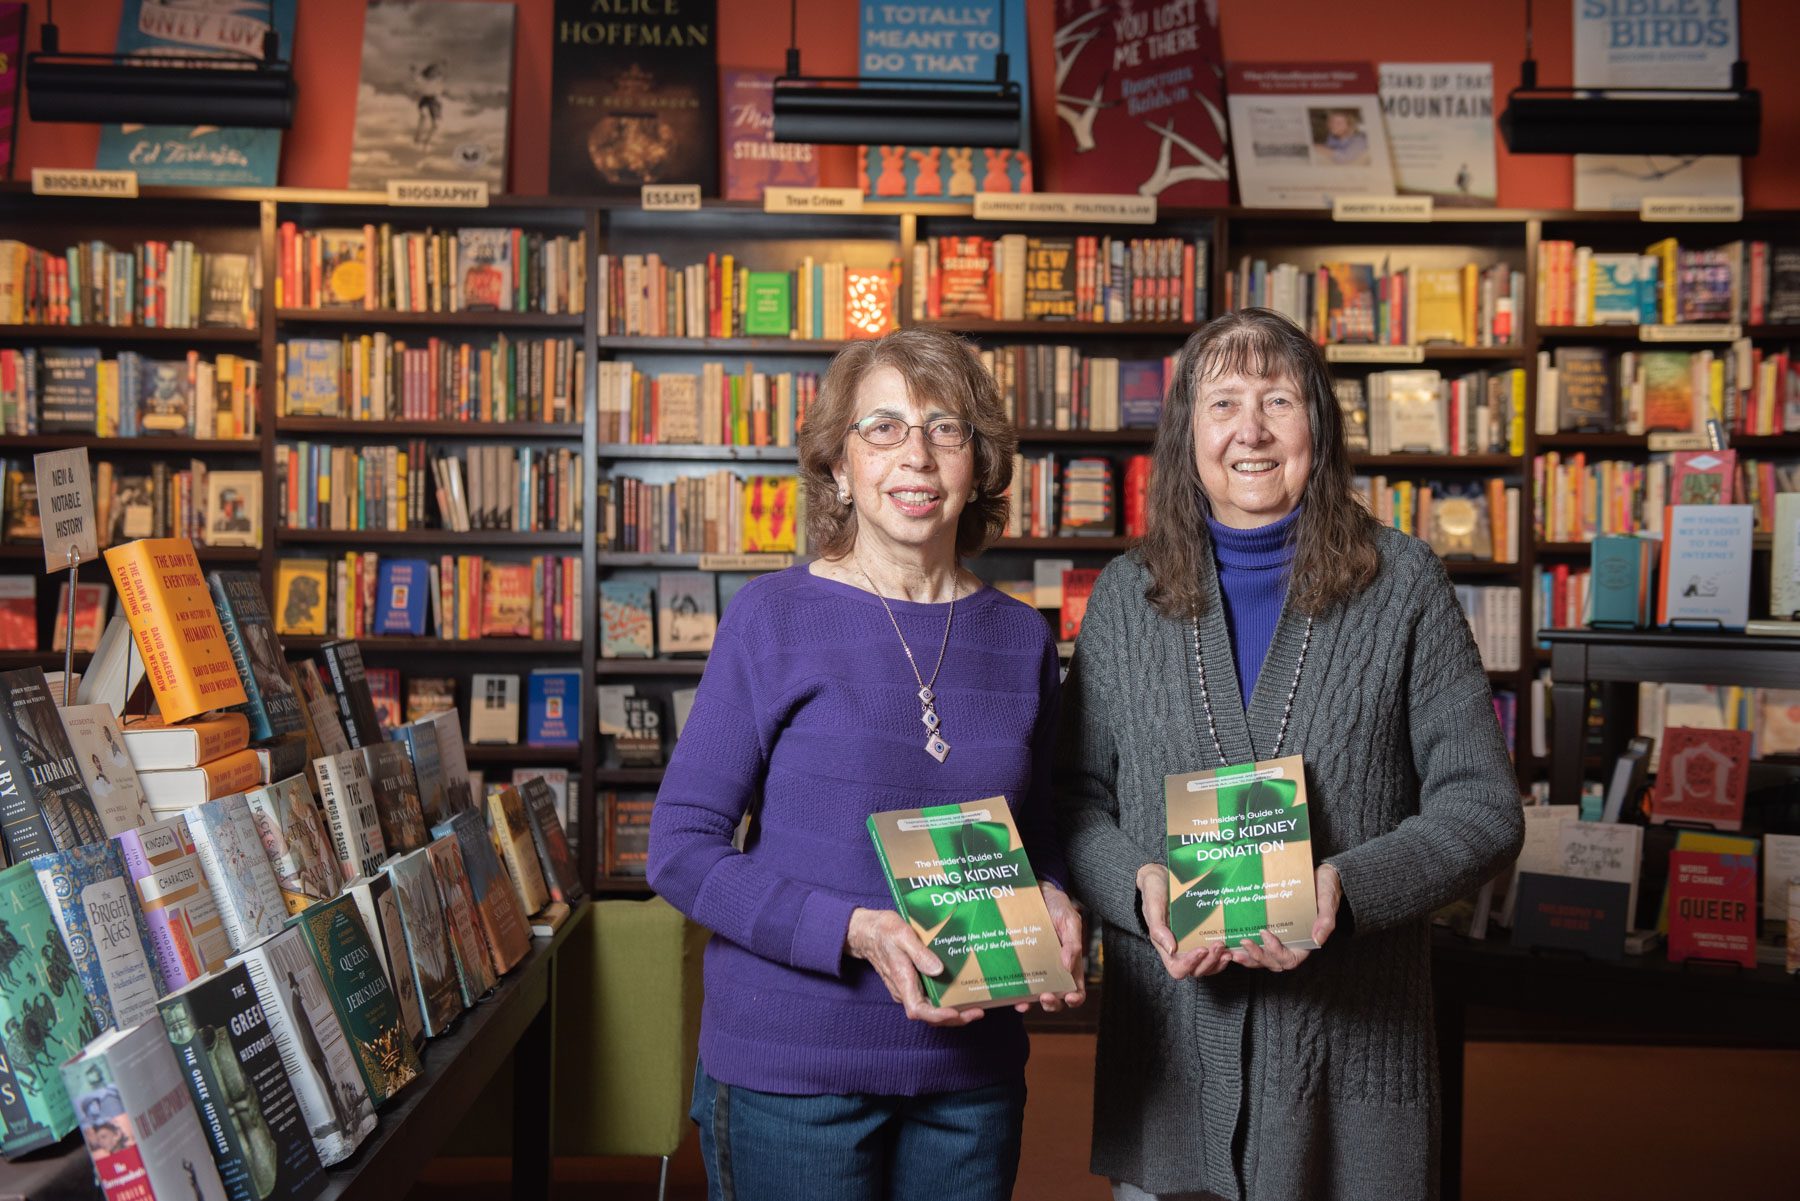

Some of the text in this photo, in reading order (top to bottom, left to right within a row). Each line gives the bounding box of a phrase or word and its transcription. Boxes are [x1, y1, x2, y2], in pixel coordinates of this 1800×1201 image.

[866, 6, 993, 25] I TOTALLY
[560, 21, 708, 46] HOFFMAN
[866, 30, 999, 50] MEANT TO
[1610, 18, 1729, 48] BIRDS
[865, 53, 979, 73] DO THAT
[1431, 74, 1452, 89] UP
[1456, 75, 1493, 89] THAT
[1382, 97, 1494, 119] MOUNTAIN
[42, 175, 128, 191] BIOGRAPHY
[397, 186, 480, 202] BIOGRAPHY
[646, 191, 697, 205] ESSAYS
[786, 195, 845, 207] True Crime
[52, 467, 74, 487] NEW &
[51, 491, 82, 513] NOTABLE
[55, 516, 83, 538] HISTORY
[154, 553, 195, 569] THE DAWN OF
[117, 566, 141, 616] EVERYTHING
[128, 560, 152, 614] THE DAWN OF
[163, 574, 200, 589] EVERYTHING
[180, 611, 190, 620] NEW
[182, 625, 218, 643] HUMANITY
[140, 630, 167, 692] DAVID WENGROW
[150, 627, 177, 684] DAVID GRAEBER
[193, 664, 210, 677] DAVID
[200, 681, 216, 694] DAVID
[30, 757, 78, 785] LIBRARY
[346, 782, 362, 806] THE
[252, 797, 271, 838] TRACE
[266, 838, 275, 848] &
[318, 764, 350, 861] HOW THE WORD IS PASSED
[1192, 818, 1209, 826] The
[1210, 813, 1246, 824] Insider's
[1247, 810, 1274, 819] Guide
[1181, 818, 1298, 845] LIVING KIDNEY
[144, 834, 174, 851] KINGDOM
[360, 832, 370, 855] IS
[1196, 839, 1285, 862] DONATION
[131, 848, 142, 866] JING
[914, 852, 1003, 869] The Insider's Guide to
[159, 867, 195, 890] CHARACTERS
[909, 863, 1020, 889] LIVING KIDNEY
[1679, 864, 1708, 874] WORDS
[1185, 888, 1220, 899] Everything
[1220, 887, 1234, 896] You
[1235, 884, 1253, 893] Need
[1261, 881, 1279, 890] Know
[1679, 874, 1724, 886] OF CHANGE
[930, 884, 1016, 907] DONATION
[1196, 899, 1211, 908] Give
[1223, 896, 1240, 906] Get)
[1251, 892, 1279, 902] Greatest
[1279, 889, 1294, 899] Gift
[89, 894, 130, 925] BRIGHT
[1680, 898, 1747, 921] QUEER
[102, 919, 131, 950] AGES
[934, 933, 967, 946] Everything
[967, 932, 981, 943] You
[981, 930, 997, 939] Need
[1005, 926, 1022, 936] Know
[151, 930, 172, 979] CHARACTERS
[159, 925, 182, 977] KINGDOM OF
[948, 946, 962, 957] Give
[973, 942, 989, 953] Get)
[989, 941, 1000, 949] the
[1000, 939, 1025, 949] Greatest
[1025, 936, 1038, 946] Gift
[340, 944, 370, 971] QUEENS
[358, 970, 366, 979] OF
[231, 983, 247, 999] THE
[346, 976, 388, 1013] JERUSALEM
[183, 1045, 230, 1154] THE GREEK HISTORIES
